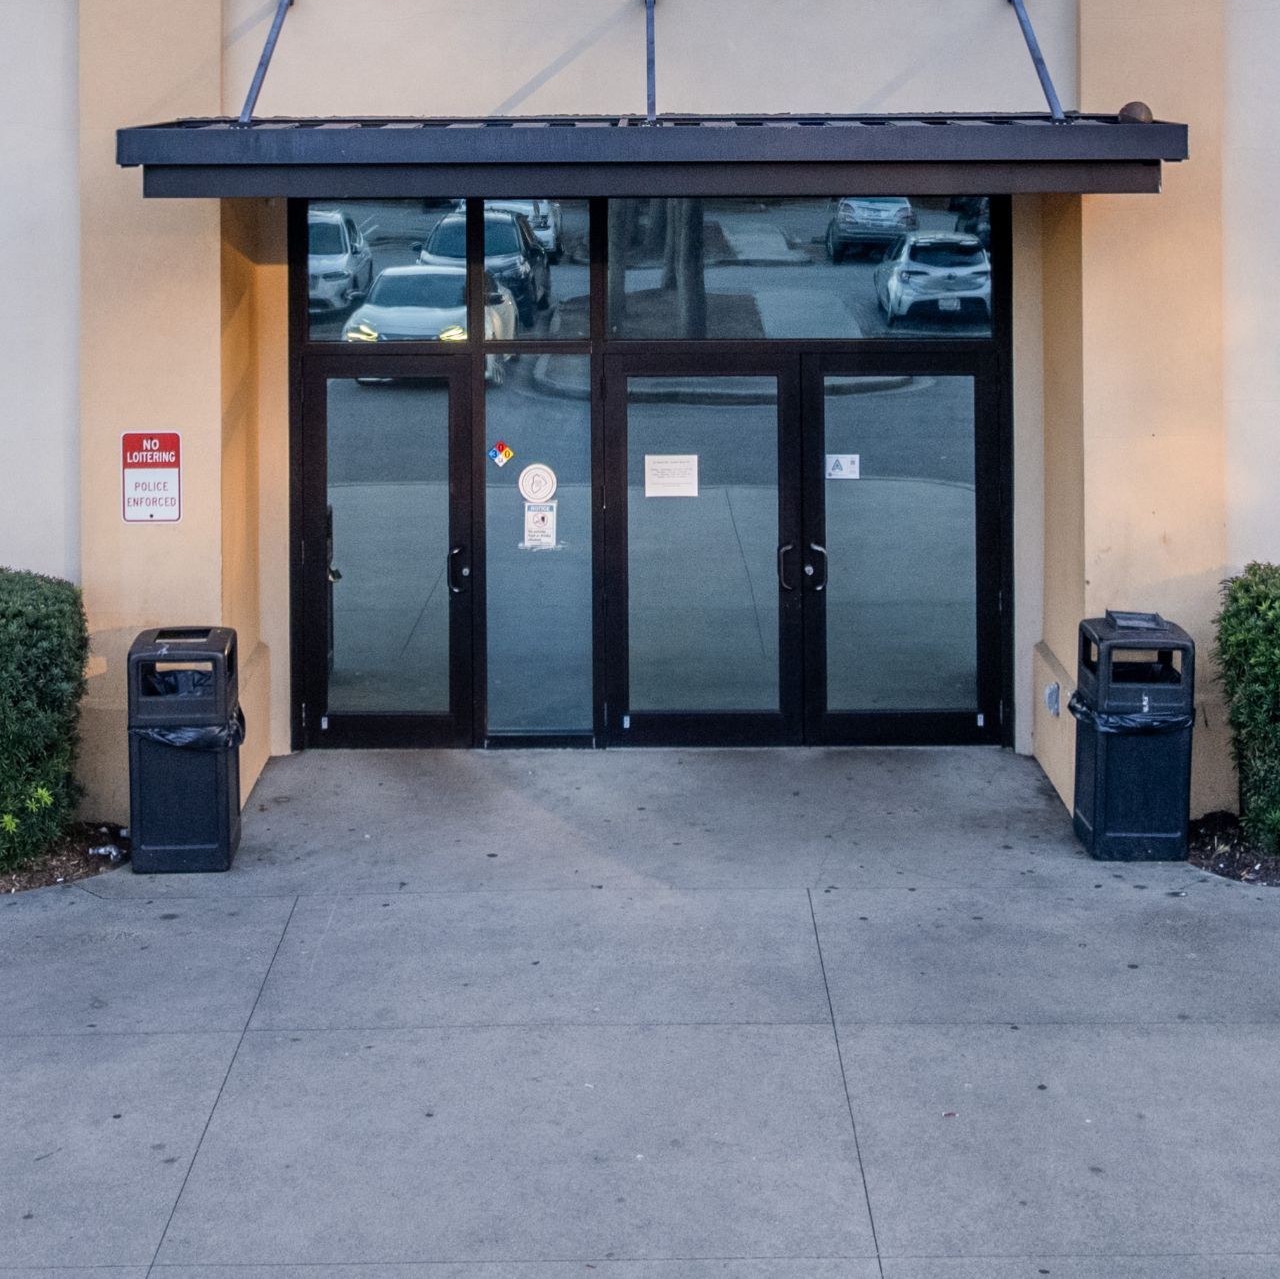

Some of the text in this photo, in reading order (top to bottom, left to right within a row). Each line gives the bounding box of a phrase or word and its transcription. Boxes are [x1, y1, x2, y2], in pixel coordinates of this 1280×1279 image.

[142, 439, 160, 451] NO
[126, 451, 176, 463] LOITERING
[134, 482, 169, 492] POLICE
[127, 497, 177, 507] ENFORCED
